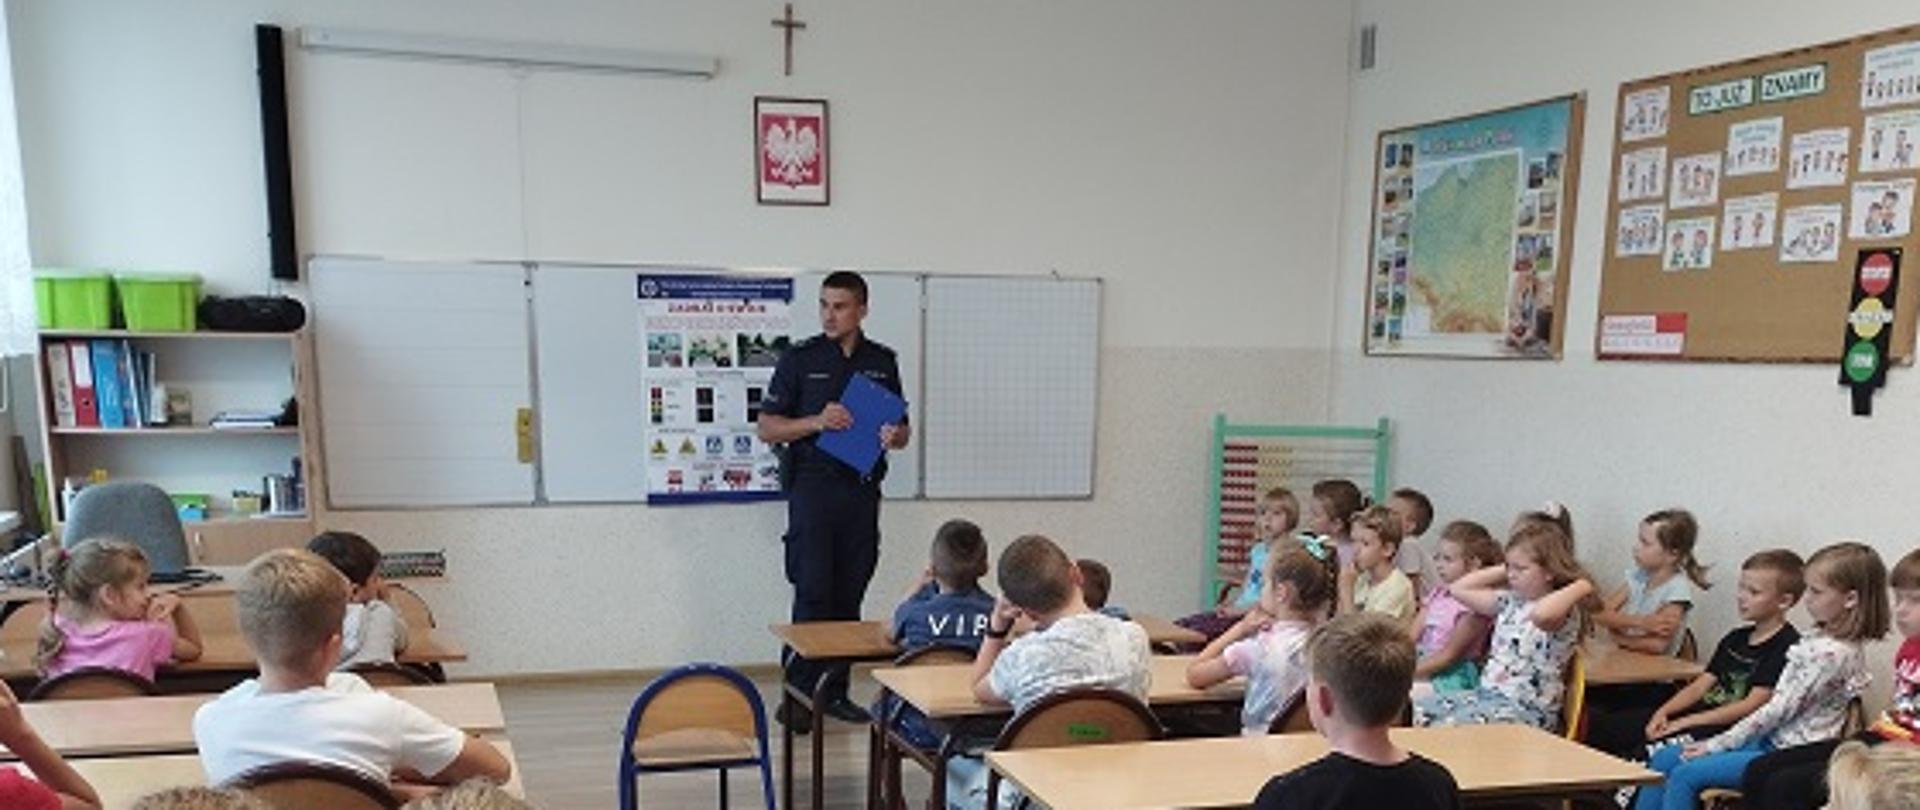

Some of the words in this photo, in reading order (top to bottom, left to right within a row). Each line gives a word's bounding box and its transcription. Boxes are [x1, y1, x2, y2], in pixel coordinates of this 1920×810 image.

[1695, 91, 1712, 108] TO
[1764, 71, 1822, 97] ZNAMY
[927, 612, 989, 637] VIP
